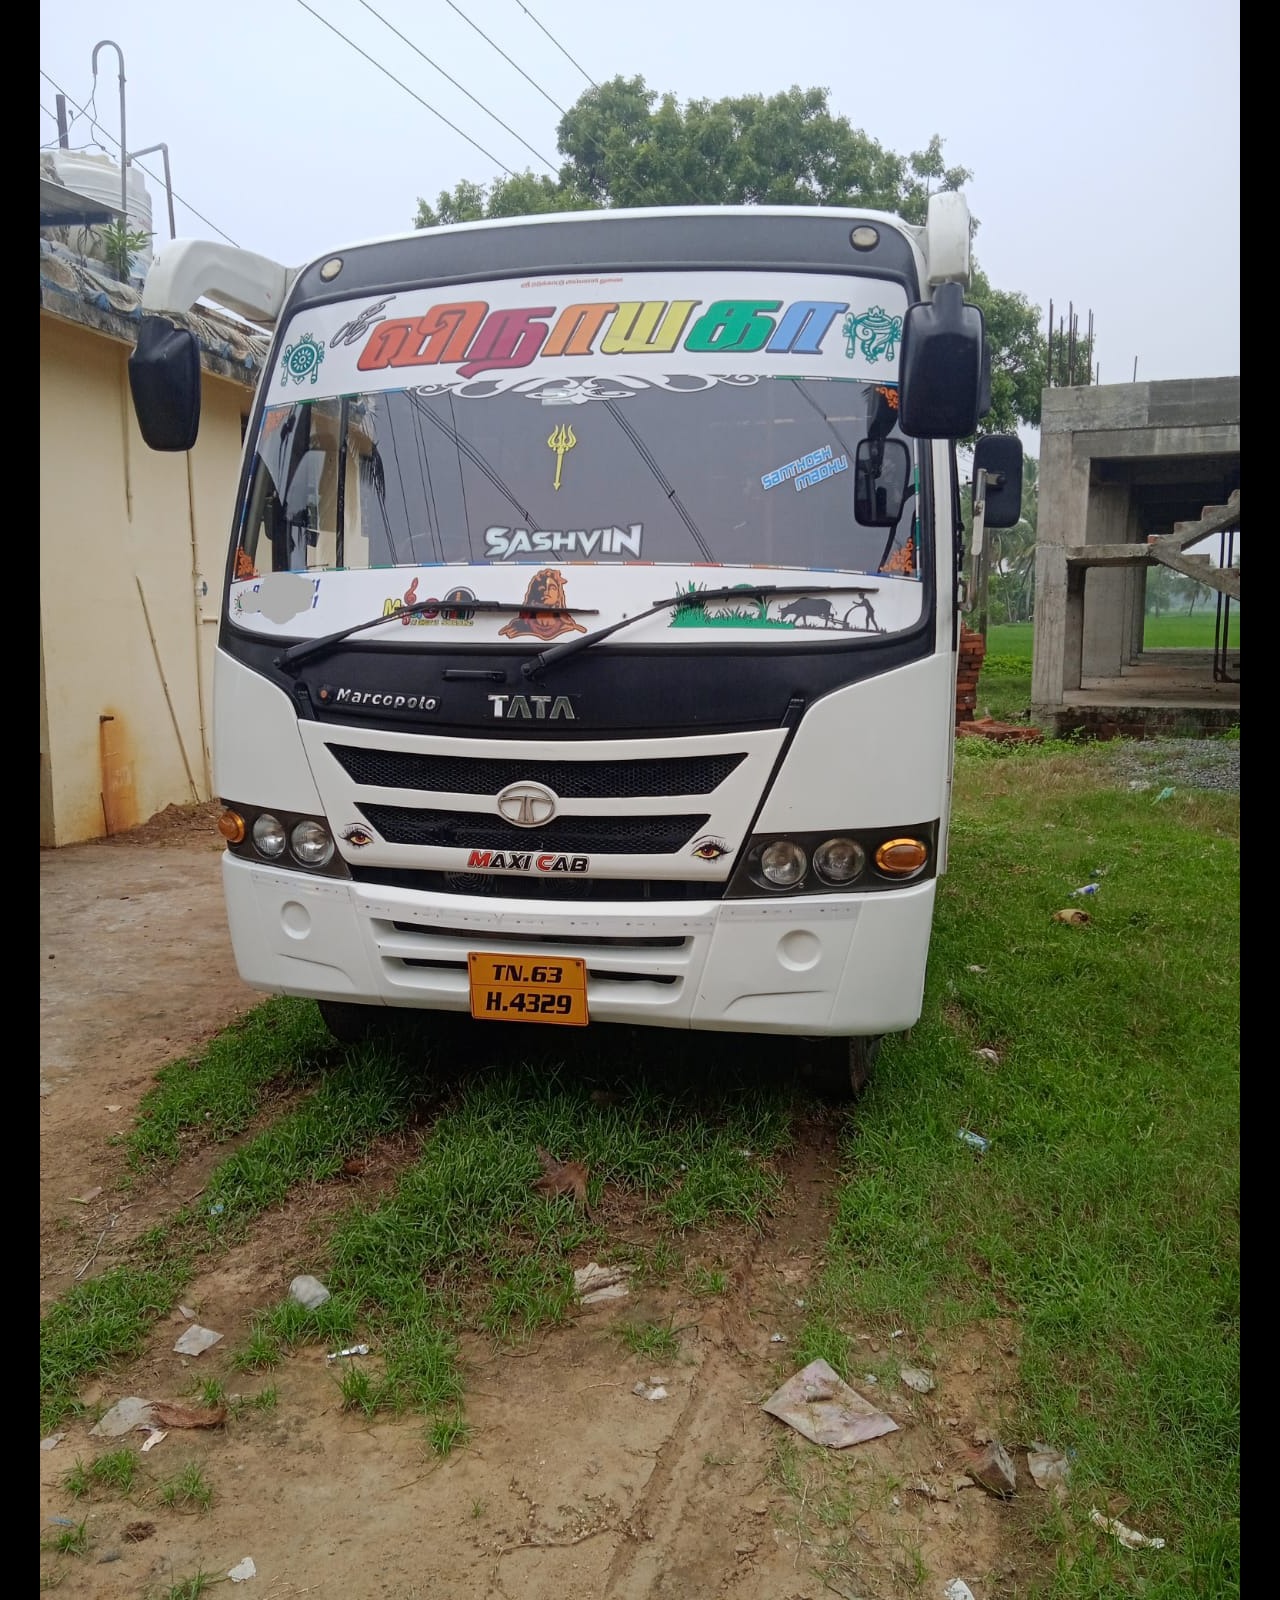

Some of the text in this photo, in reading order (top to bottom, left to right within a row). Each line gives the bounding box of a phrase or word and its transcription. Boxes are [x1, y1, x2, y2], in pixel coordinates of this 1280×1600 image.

[357, 300, 848, 379] விநாயகா
[485, 523, 643, 560] SASHVIN
[336, 688, 436, 710] Marcopolo
[488, 695, 575, 719] TATA
[467, 850, 590, 873] MAXI CAB
[492, 964, 563, 984] TN.63
[486, 991, 572, 1015] H.4329
